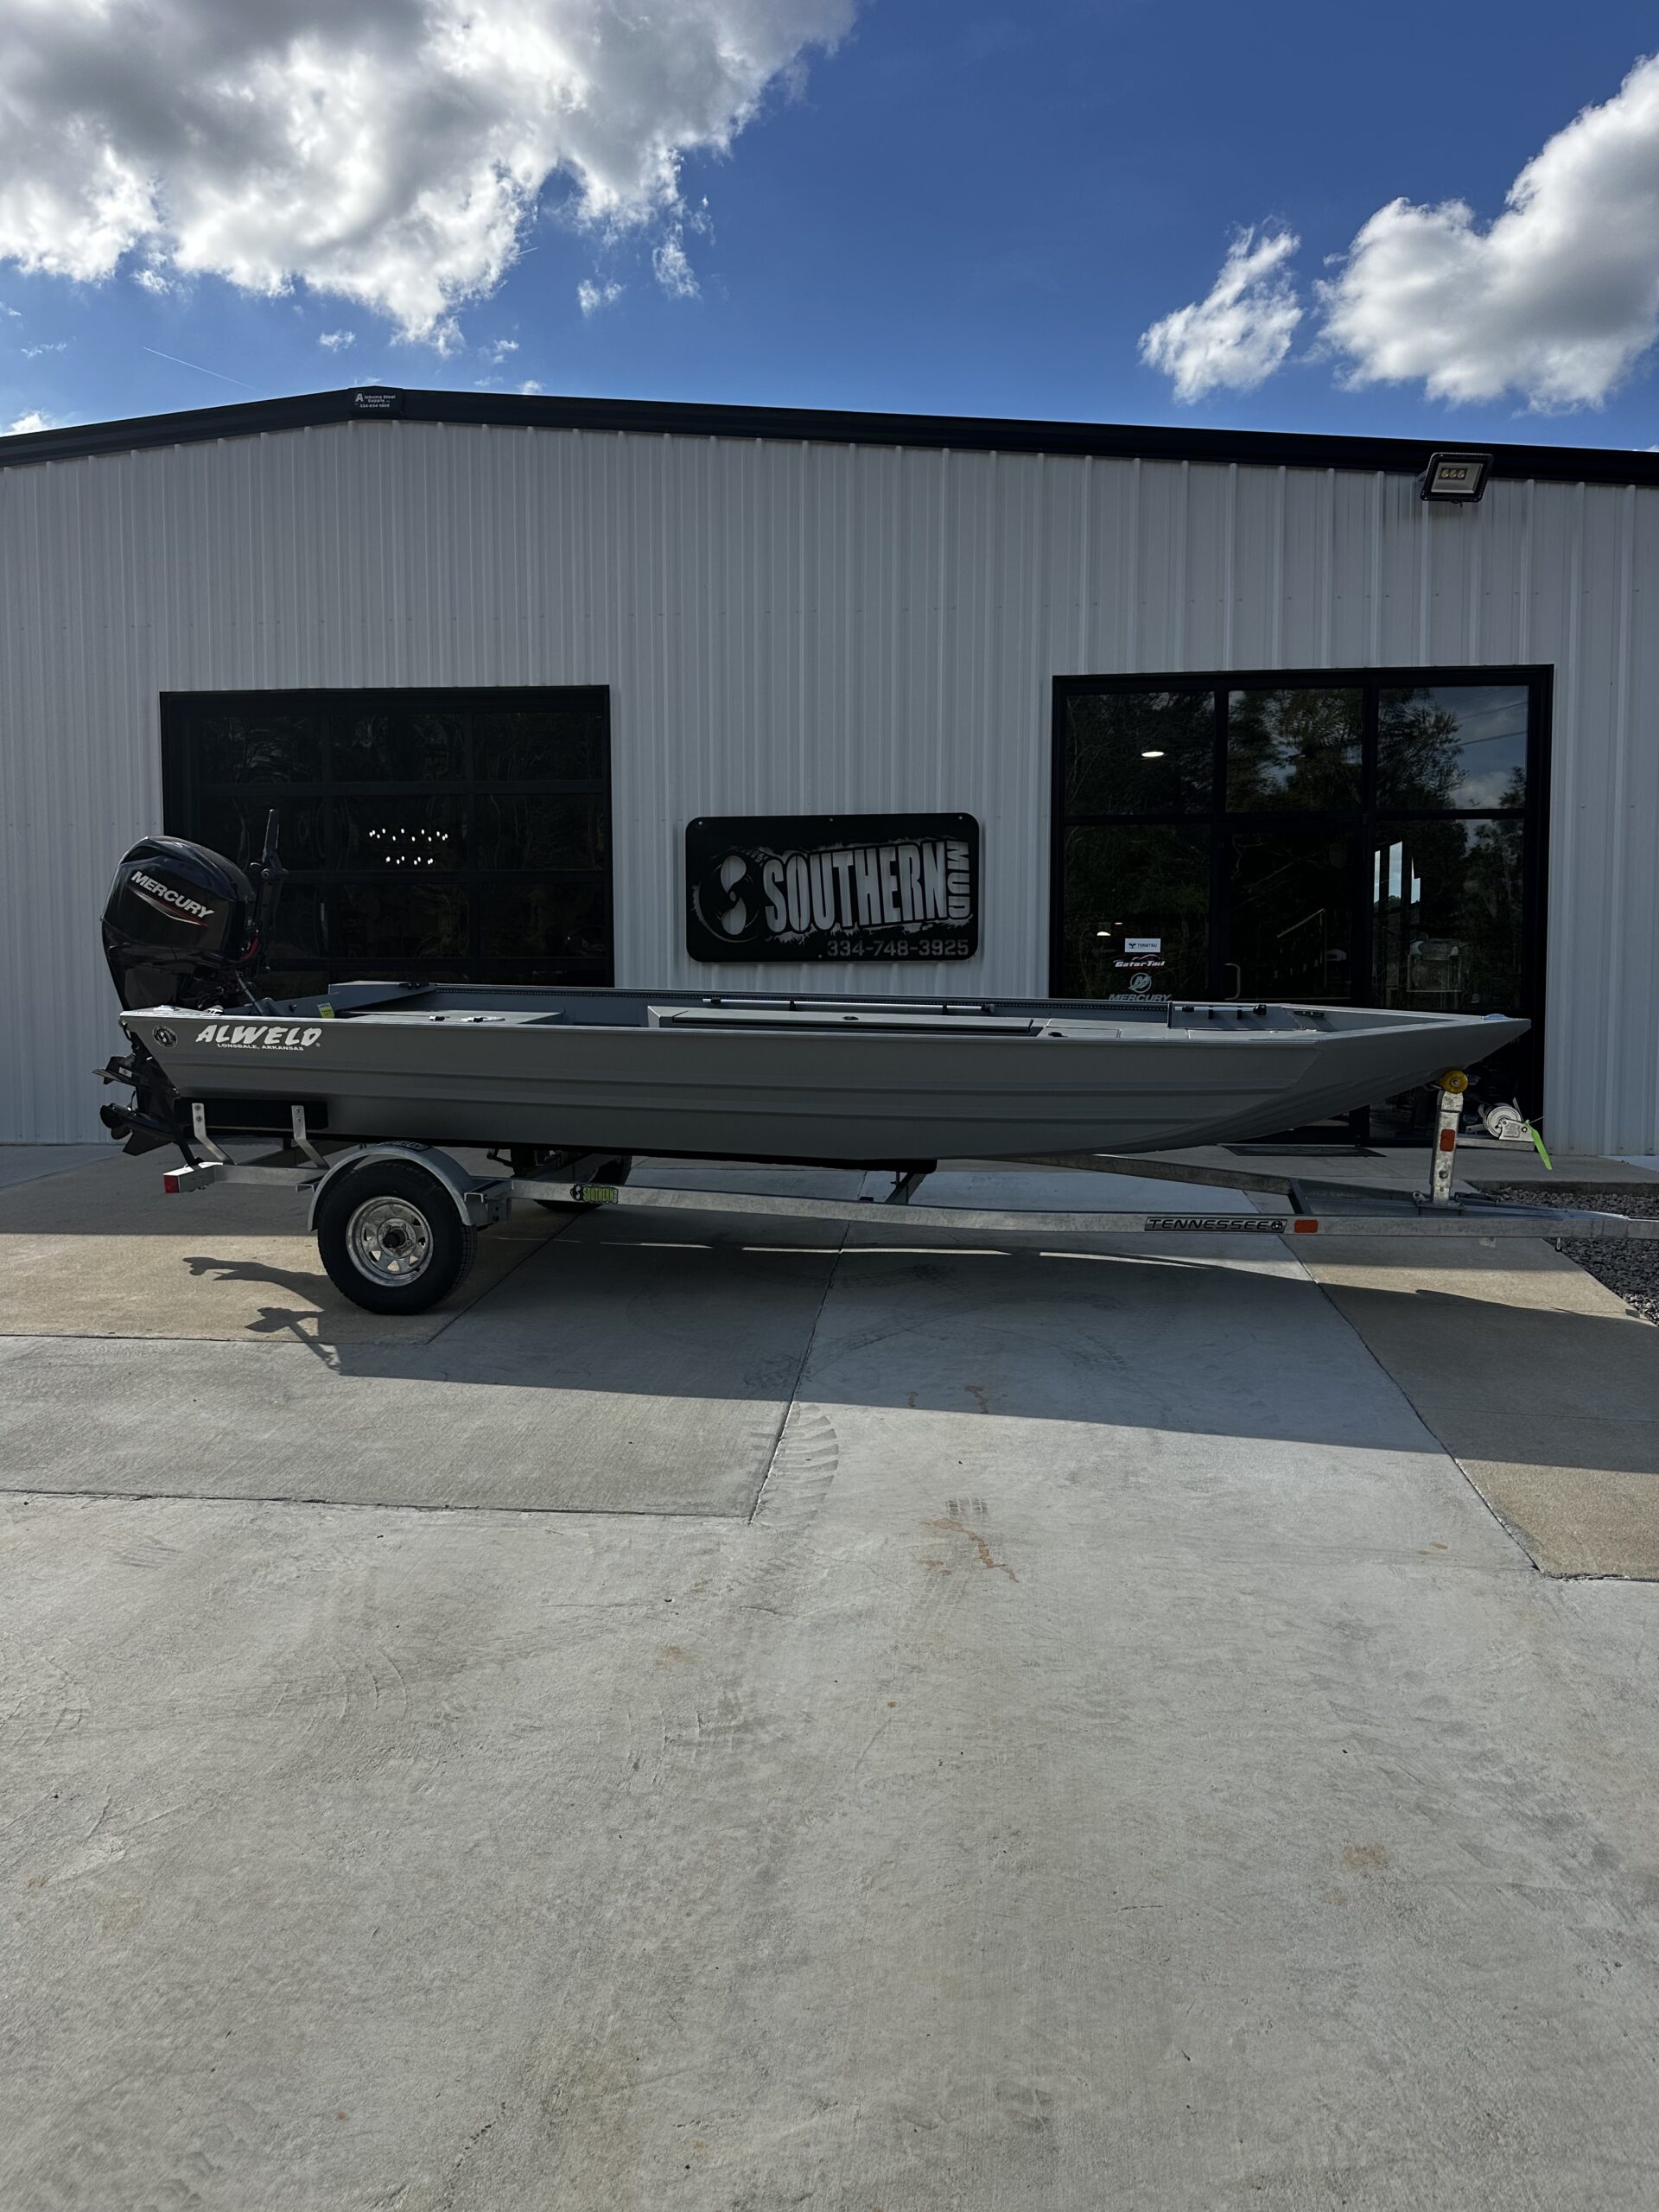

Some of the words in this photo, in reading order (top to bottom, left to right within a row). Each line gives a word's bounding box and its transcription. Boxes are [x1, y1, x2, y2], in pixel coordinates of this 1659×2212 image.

[763, 842, 947, 932] SOUTHERN
[947, 842, 970, 919] MUD
[131, 871, 214, 918] MERCURY
[827, 939, 969, 957] 334-748-3925
[195, 1025, 322, 1046] ALWELD
[583, 1186, 613, 1203] SOUTHERN
[1149, 1219, 1269, 1230] TENNESSEE
